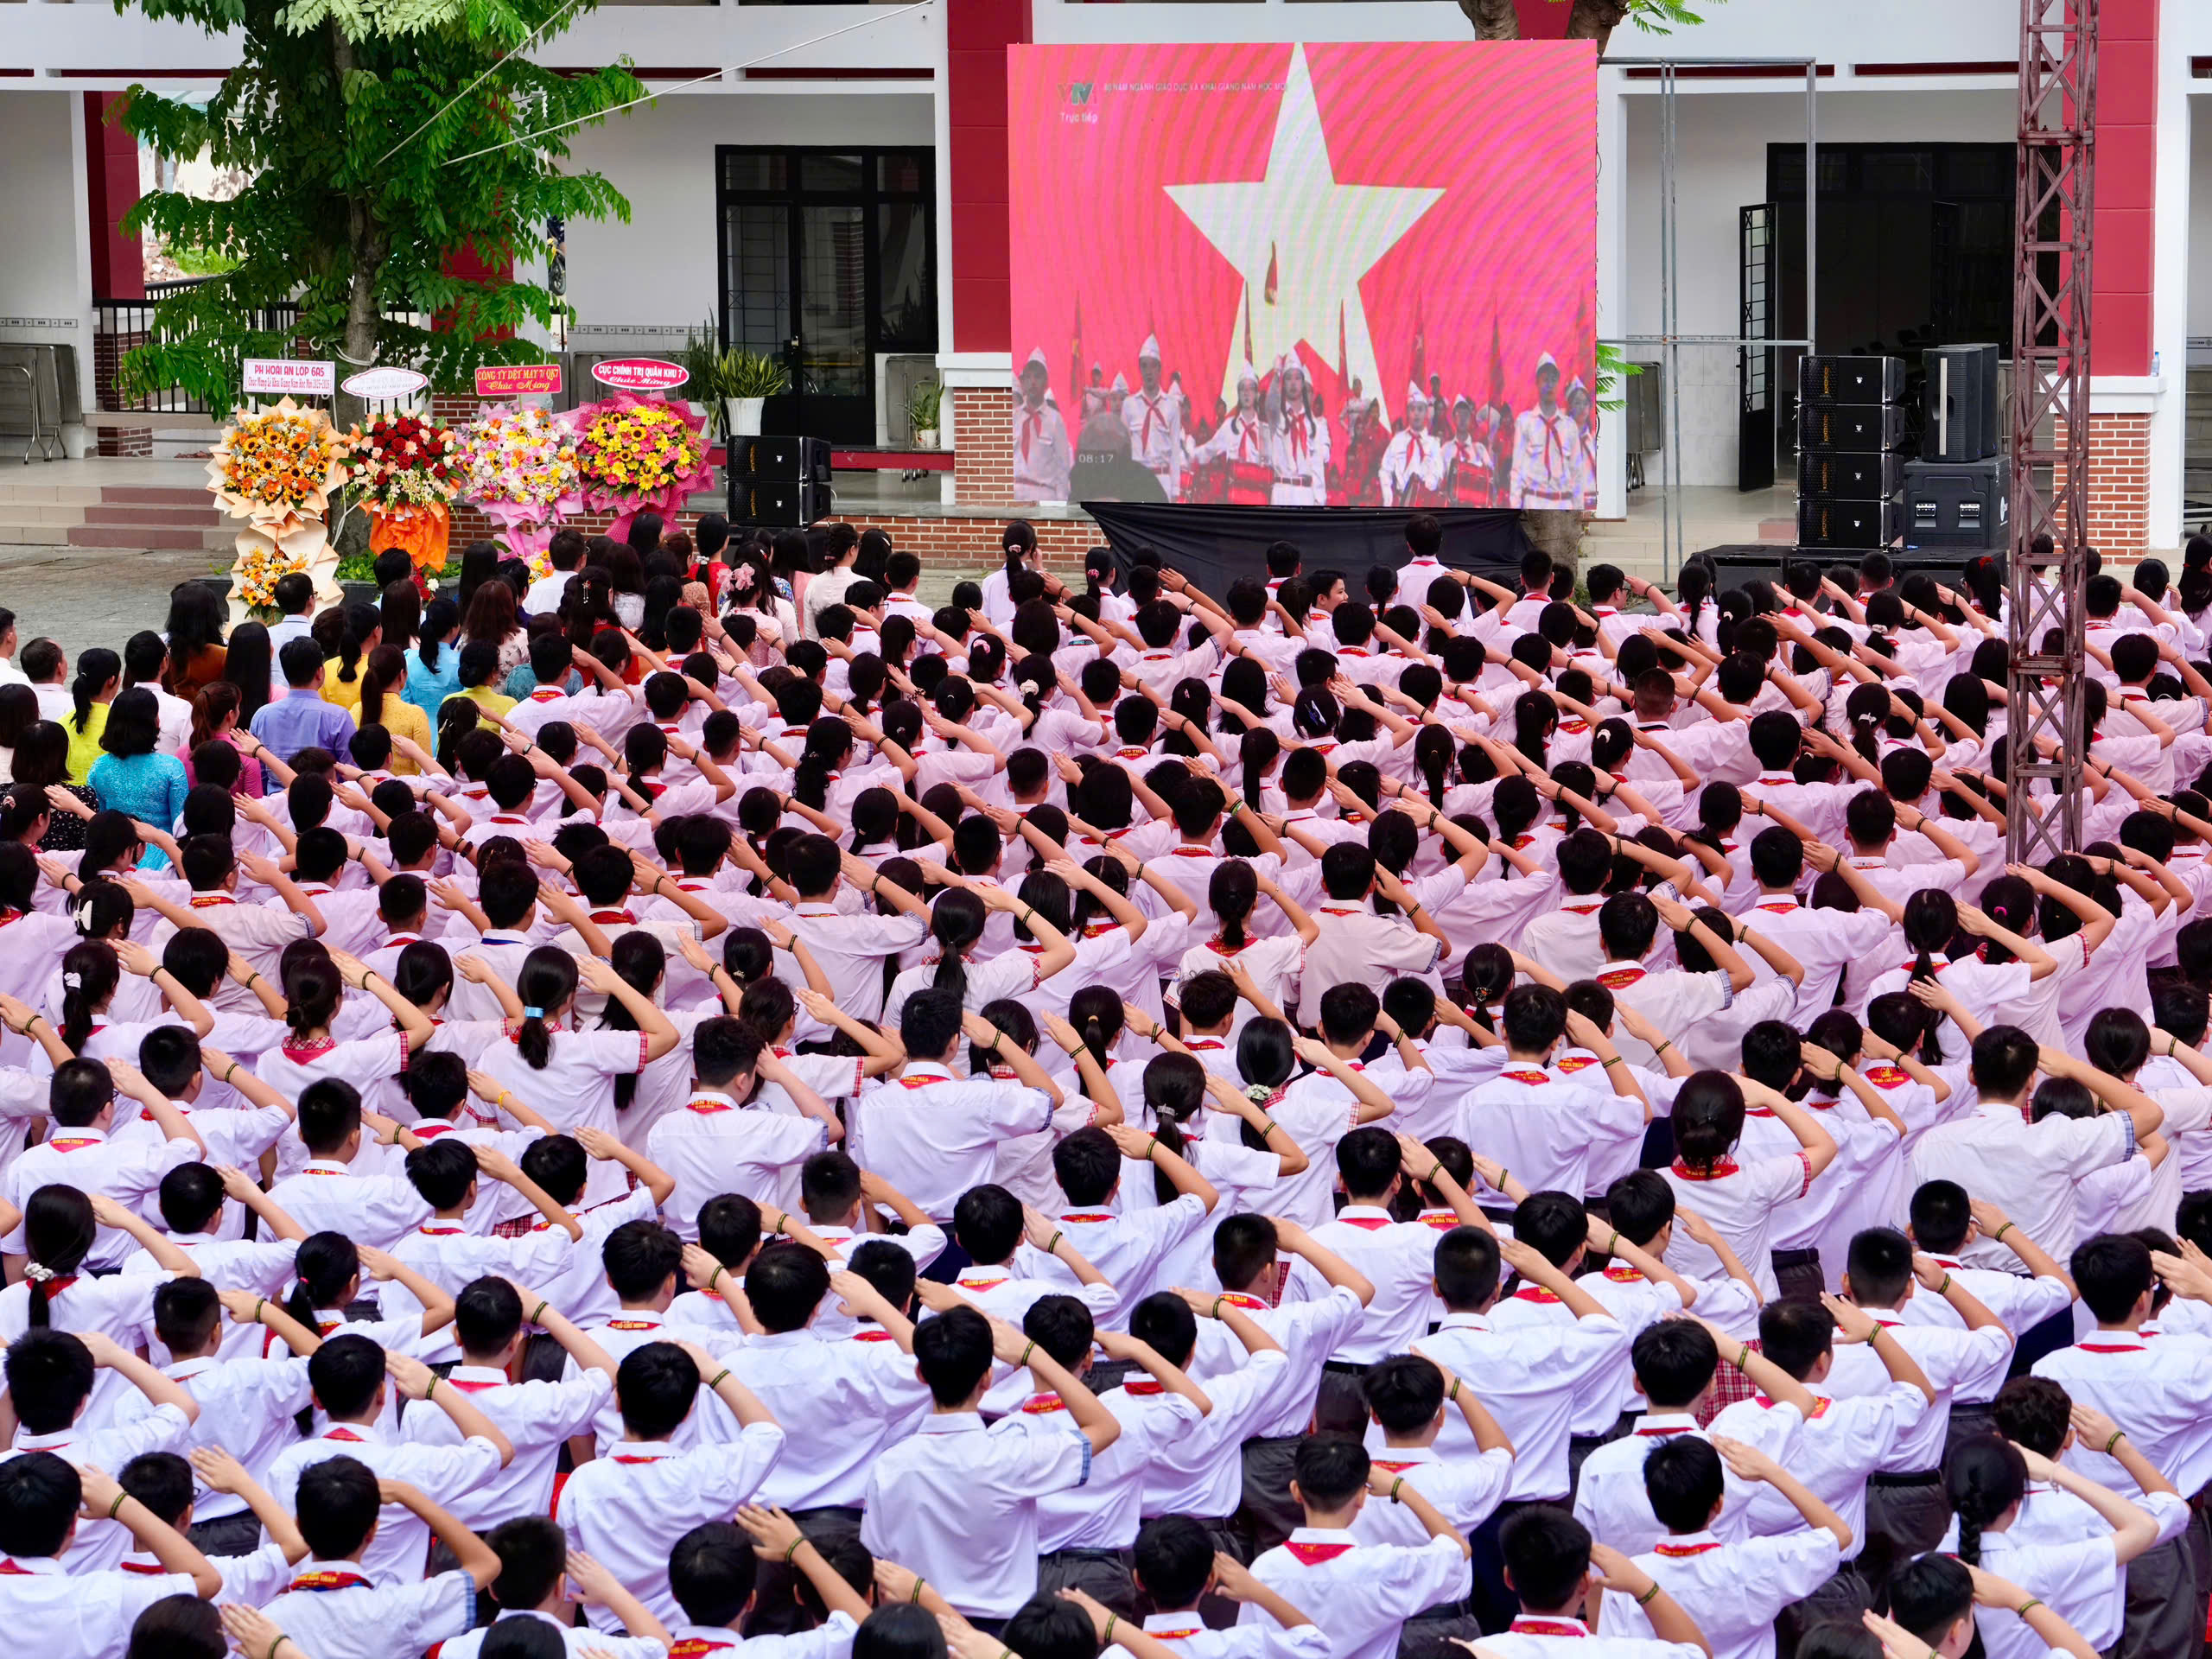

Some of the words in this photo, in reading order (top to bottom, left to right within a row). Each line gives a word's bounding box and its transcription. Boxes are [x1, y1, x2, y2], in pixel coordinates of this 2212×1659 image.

[664, 369, 677, 378] KHU
[678, 369, 683, 378] 7
[1078, 454, 1114, 463] 08:17
